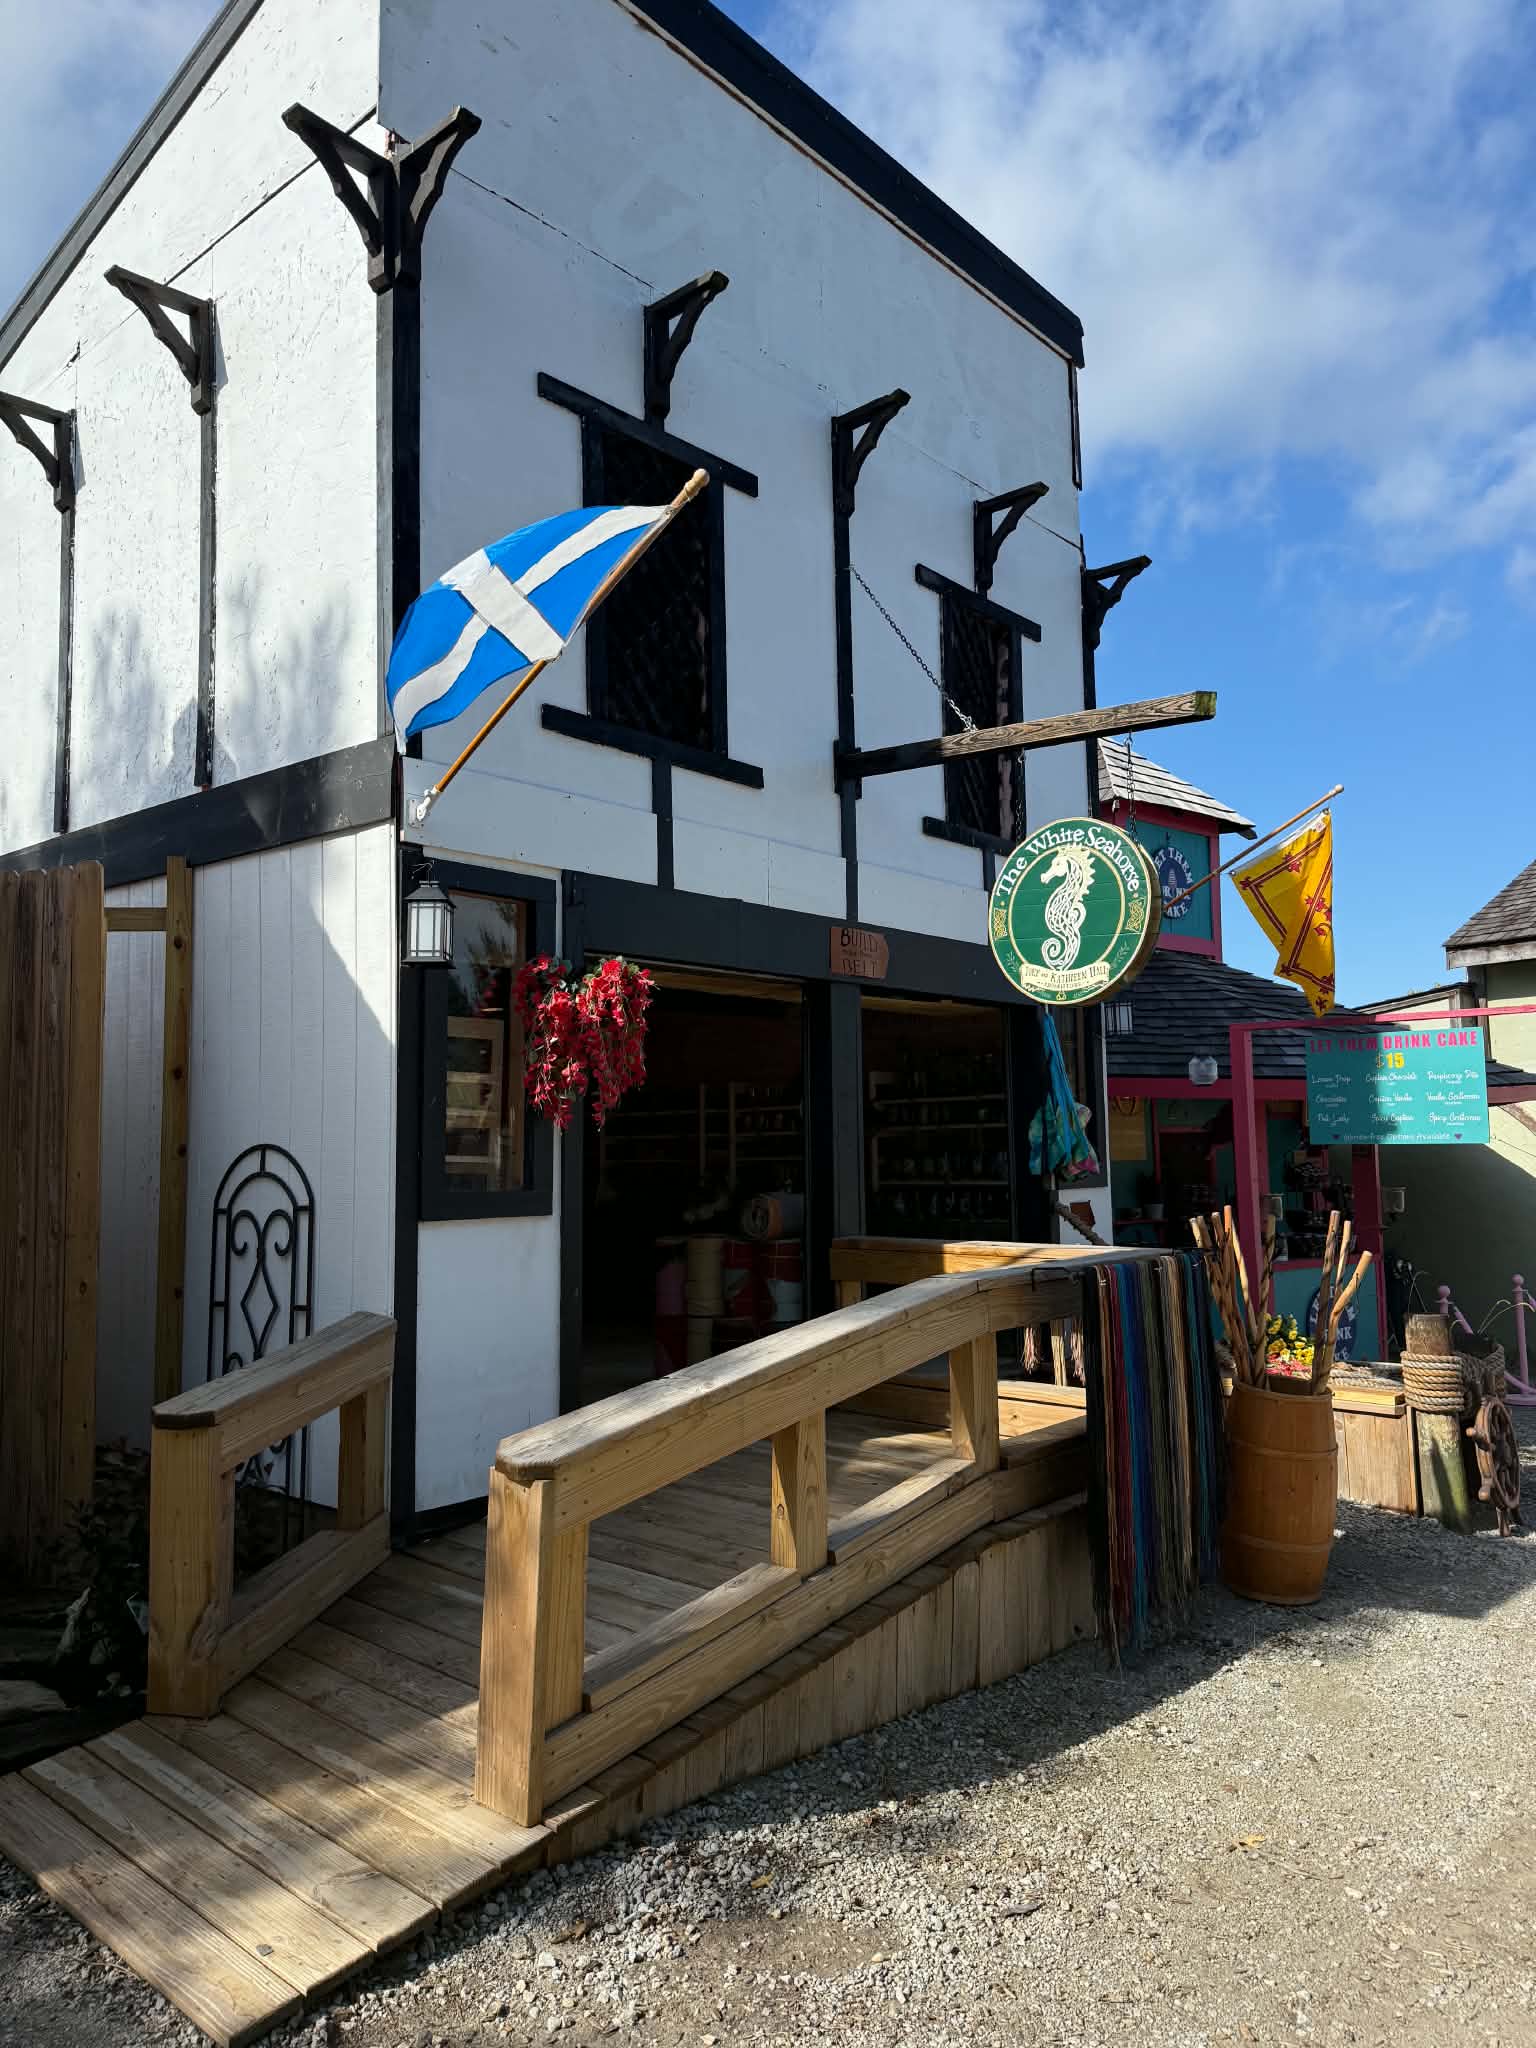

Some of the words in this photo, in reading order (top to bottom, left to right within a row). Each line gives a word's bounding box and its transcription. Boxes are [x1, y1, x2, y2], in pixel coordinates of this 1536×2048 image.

[996, 856, 1028, 897] The
[1025, 827, 1085, 856] White
[1085, 826, 1140, 892] Seahorse
[1168, 847, 1193, 884] THEM
[1310, 1039, 1332, 1053] LET
[1338, 1037, 1377, 1052] THEM
[1383, 1033, 1431, 1049] DRINK
[1437, 1030, 1477, 1047] CAKE
[1376, 1052, 1404, 1069] $15
